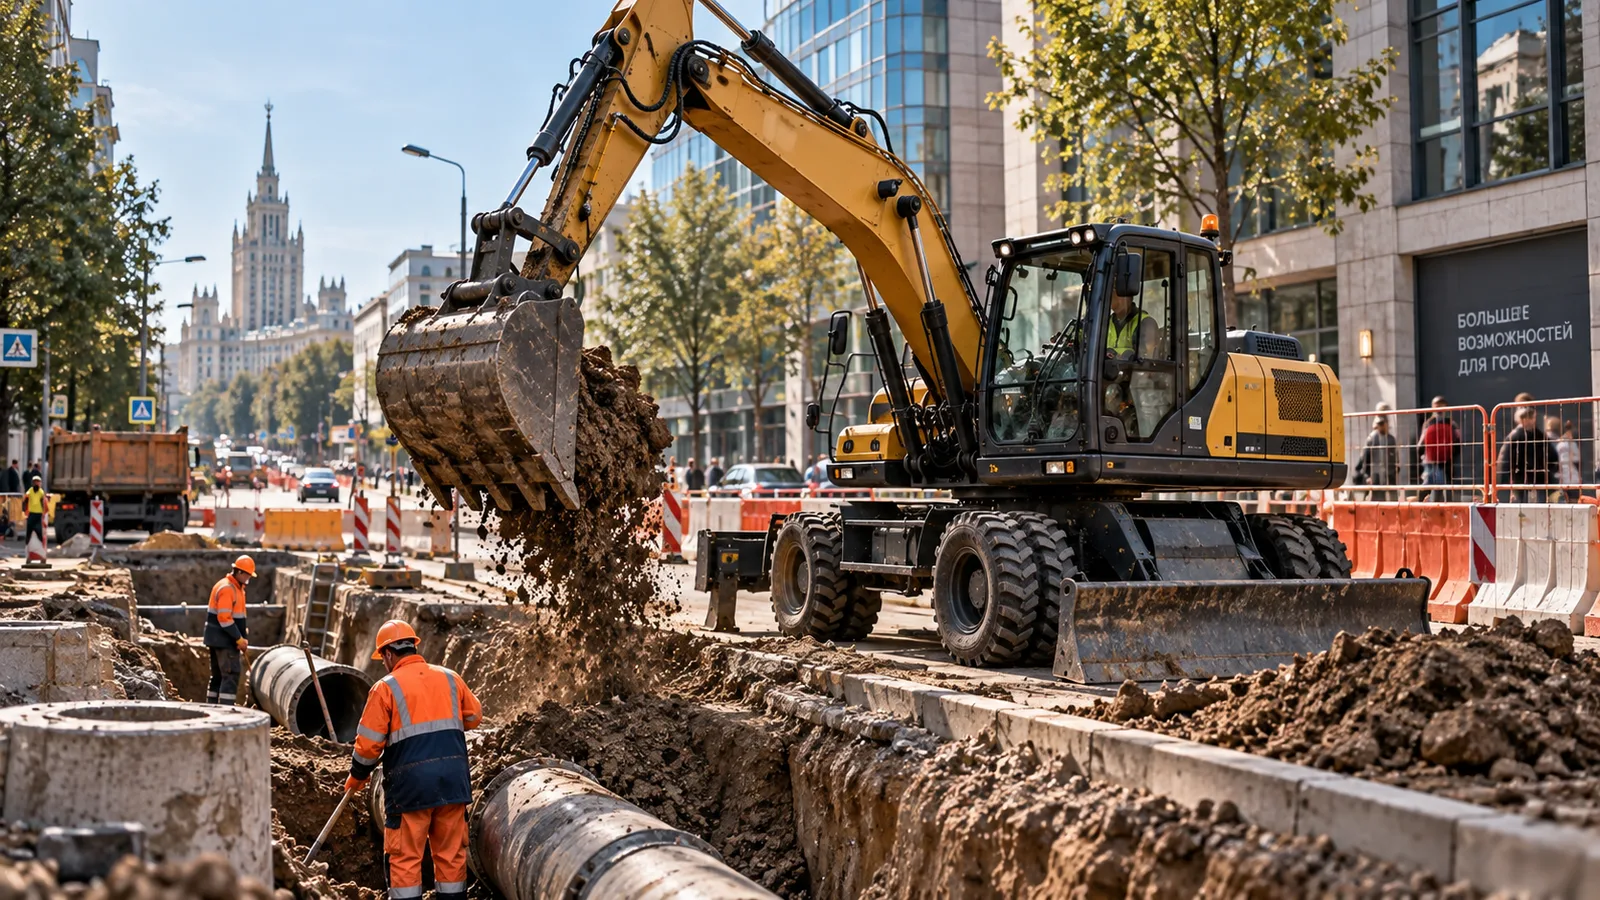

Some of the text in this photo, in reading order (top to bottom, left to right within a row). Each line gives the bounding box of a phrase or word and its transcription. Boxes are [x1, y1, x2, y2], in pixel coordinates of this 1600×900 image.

[1458, 320, 1573, 351] ВОЗМОЖНОСТЕЙ
[1458, 351, 1551, 377] ДЛЯ ГОРОДА
